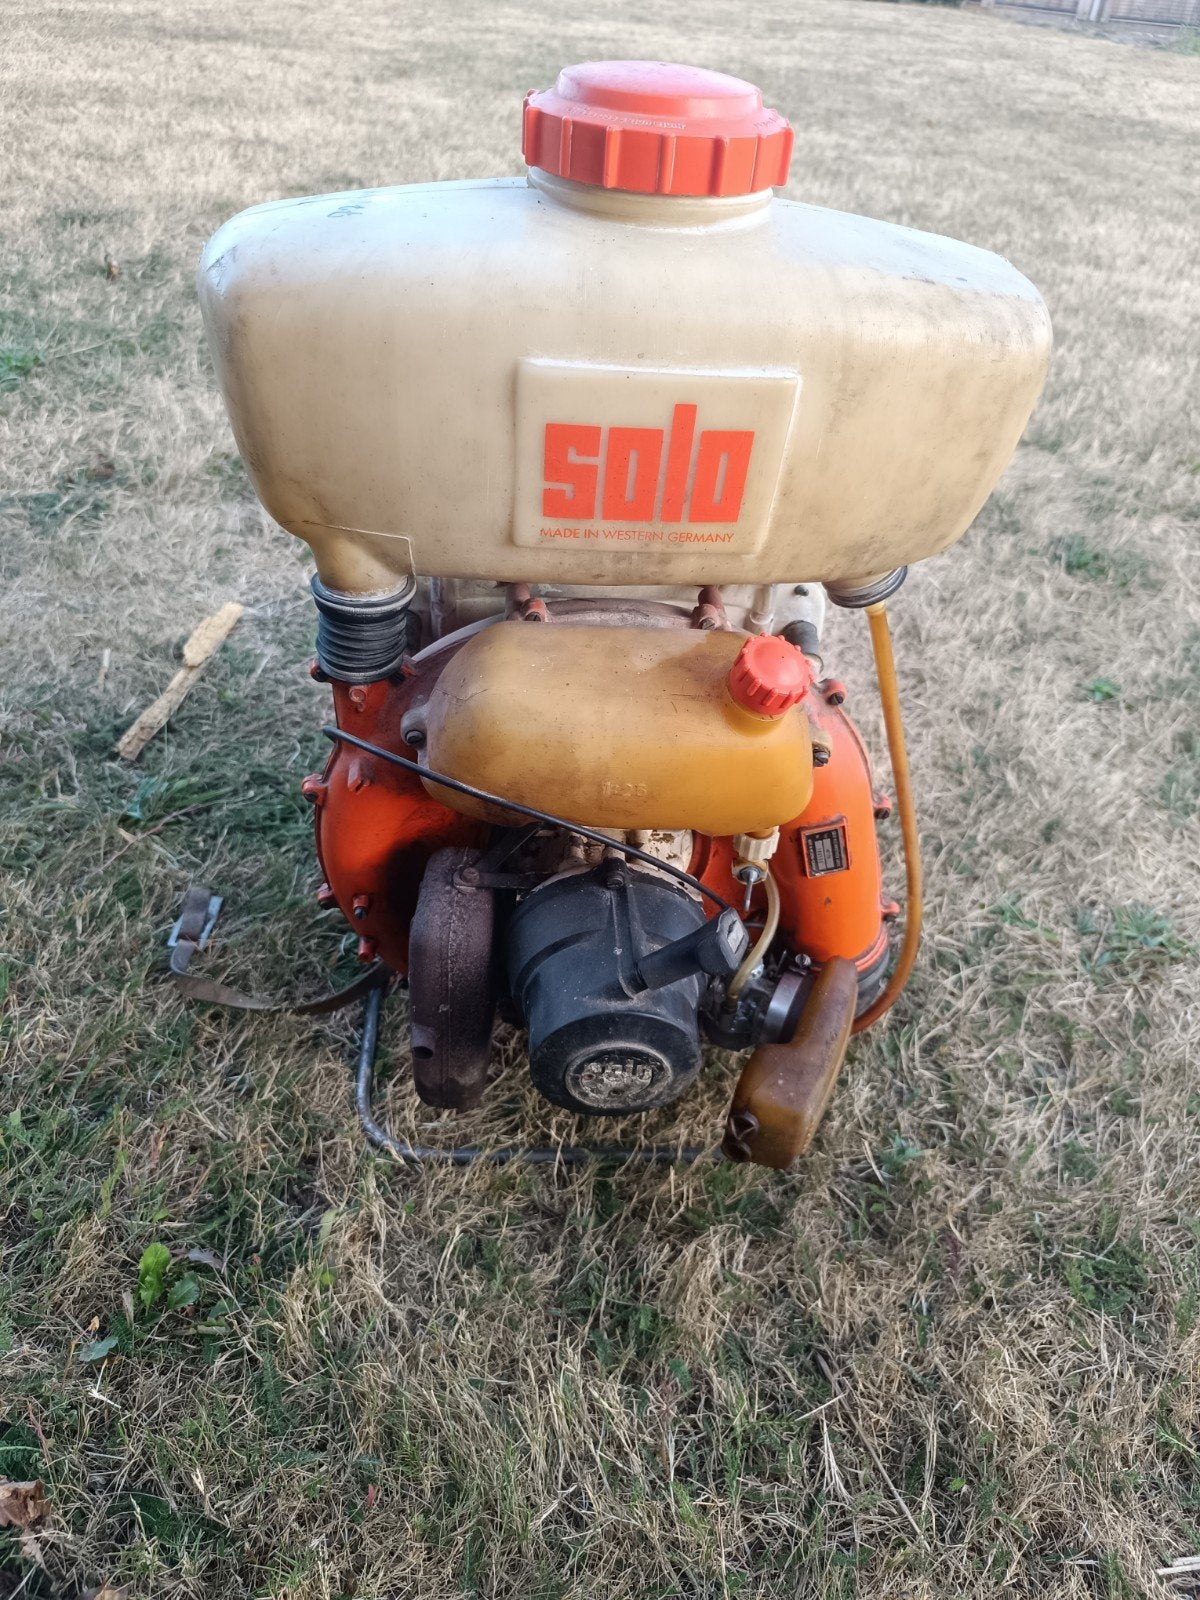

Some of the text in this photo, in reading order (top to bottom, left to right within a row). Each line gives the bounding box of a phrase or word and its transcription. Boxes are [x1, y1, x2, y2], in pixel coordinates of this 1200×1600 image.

[542, 403, 755, 522] solo
[540, 527, 735, 543] MADE IN WESTERN GERMANY
